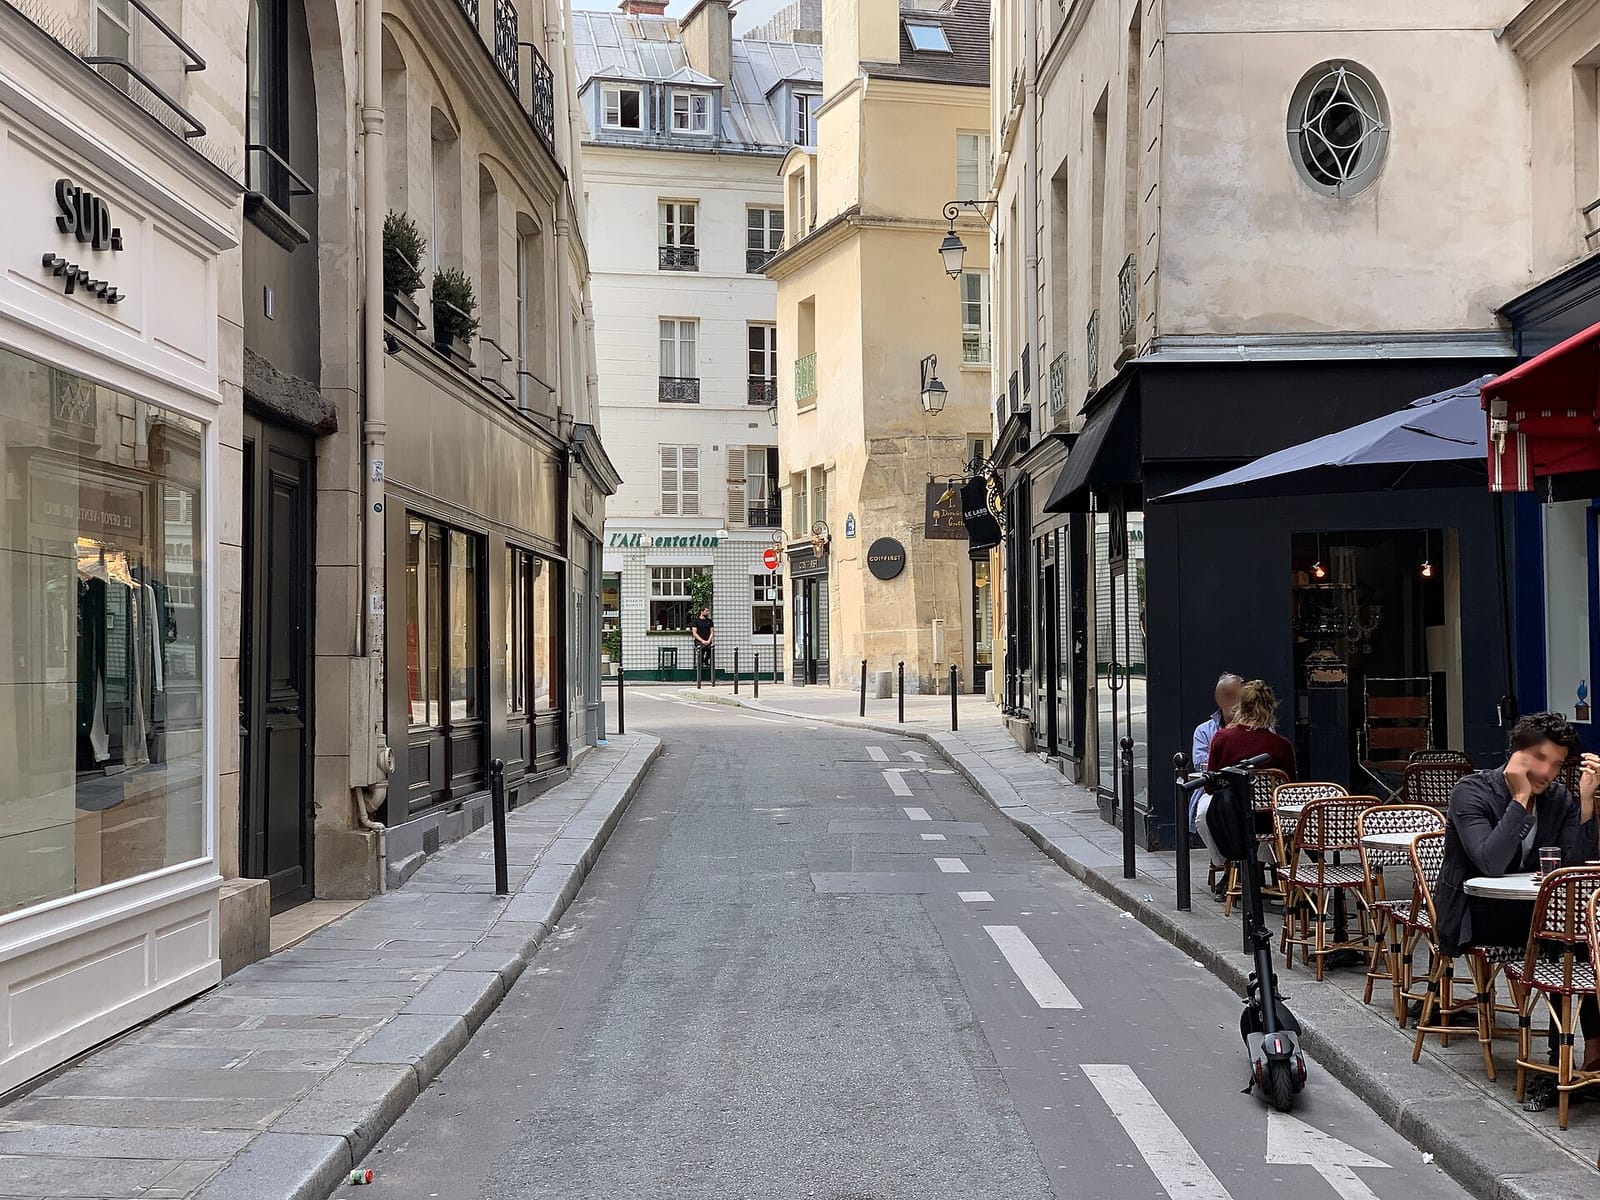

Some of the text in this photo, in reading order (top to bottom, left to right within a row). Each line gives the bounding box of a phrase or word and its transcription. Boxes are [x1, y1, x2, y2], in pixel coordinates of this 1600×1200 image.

[55, 178, 111, 251] SUD
[964, 510, 972, 518] LE
[972, 508, 987, 516] LABO
[609, 533, 718, 547] l'Alientation
